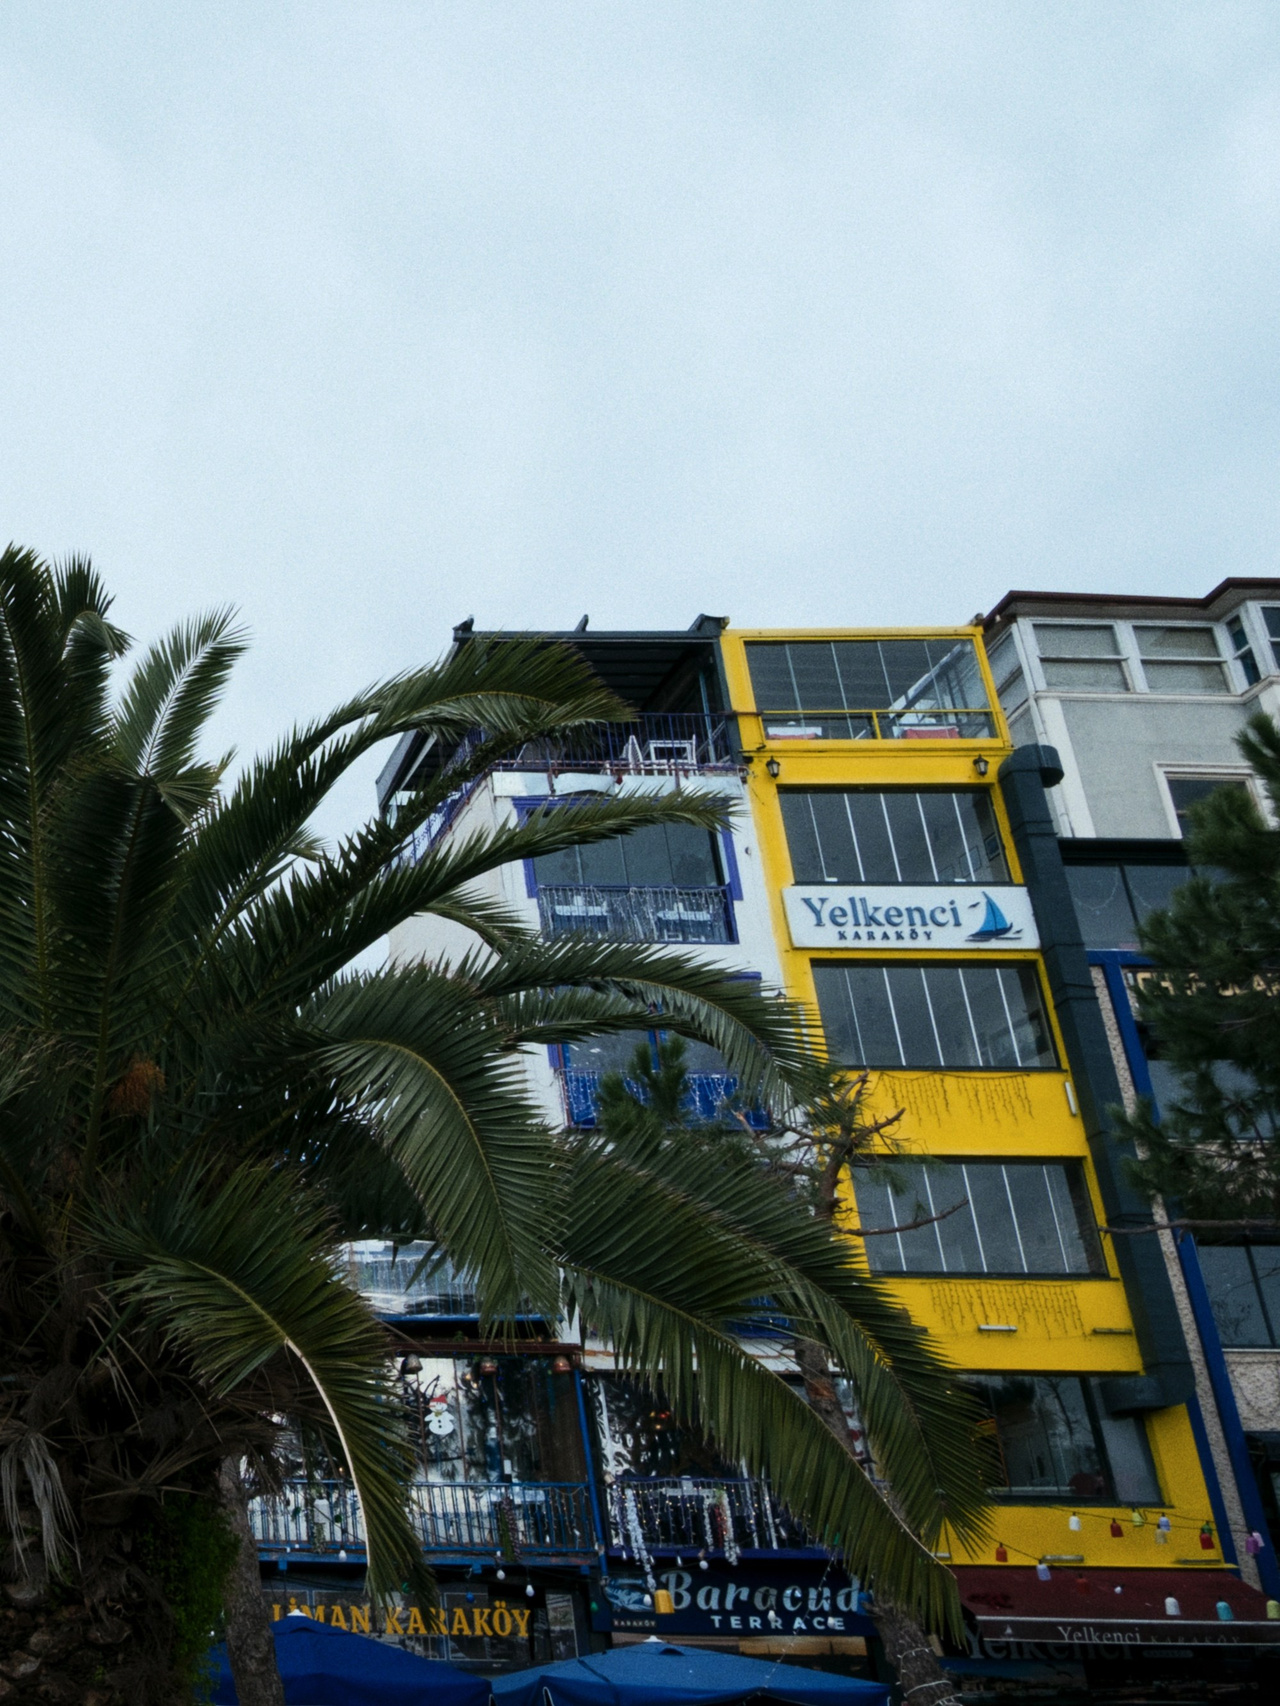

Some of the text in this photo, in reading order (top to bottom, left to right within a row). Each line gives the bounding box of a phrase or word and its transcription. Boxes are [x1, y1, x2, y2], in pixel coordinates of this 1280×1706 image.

[801, 896, 962, 928] Yelkenci
[837, 928, 933, 941] KARAKÖY
[659, 1569, 872, 1613] Baracud
[384, 1599, 532, 1637] KARAKÖY
[710, 1614, 846, 1631] TERRACE
[1057, 1625, 1141, 1643] Yelkenci
